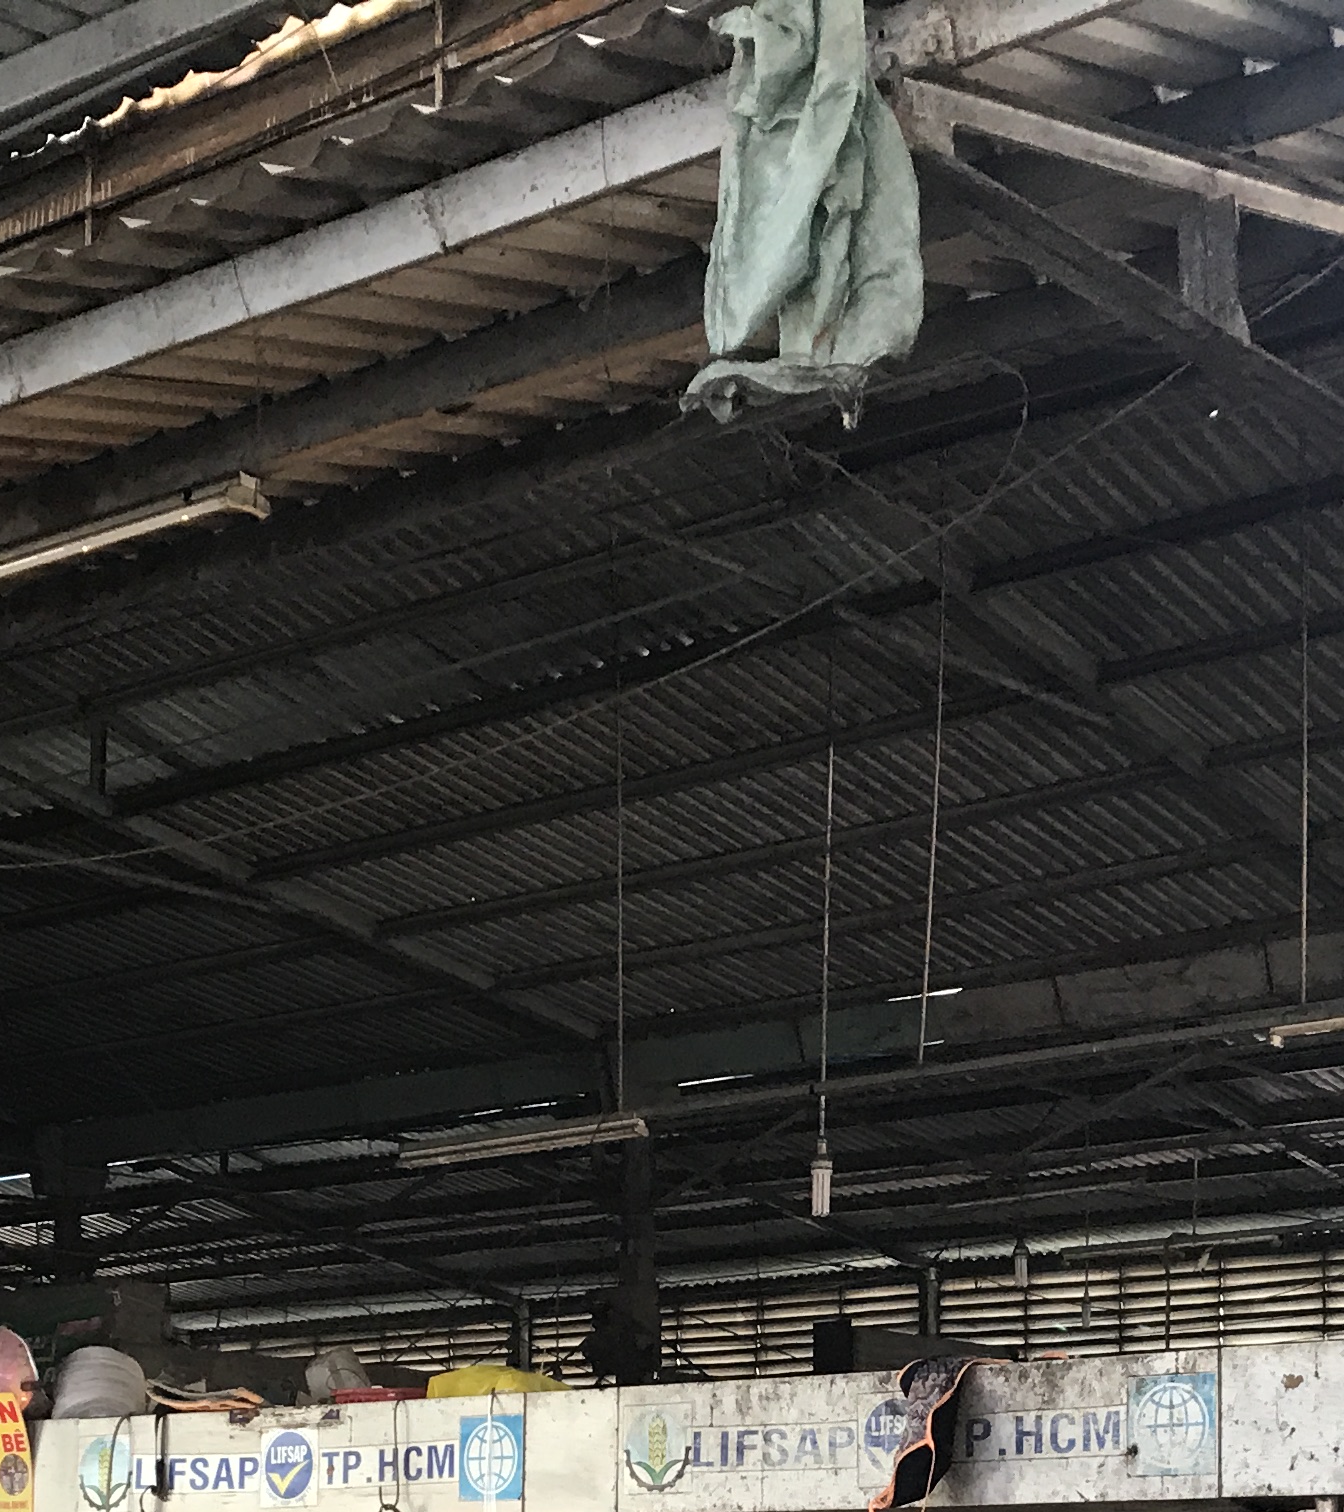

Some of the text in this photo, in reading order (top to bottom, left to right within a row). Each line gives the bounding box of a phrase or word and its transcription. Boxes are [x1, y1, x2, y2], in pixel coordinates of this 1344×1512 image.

[0, 1428, 27, 1453] BÊ
[691, 1410, 1121, 1467] LIFSAP LIFS P.HCM
[134, 1443, 456, 1491] LFSAP LIFSAP TP.HCM
